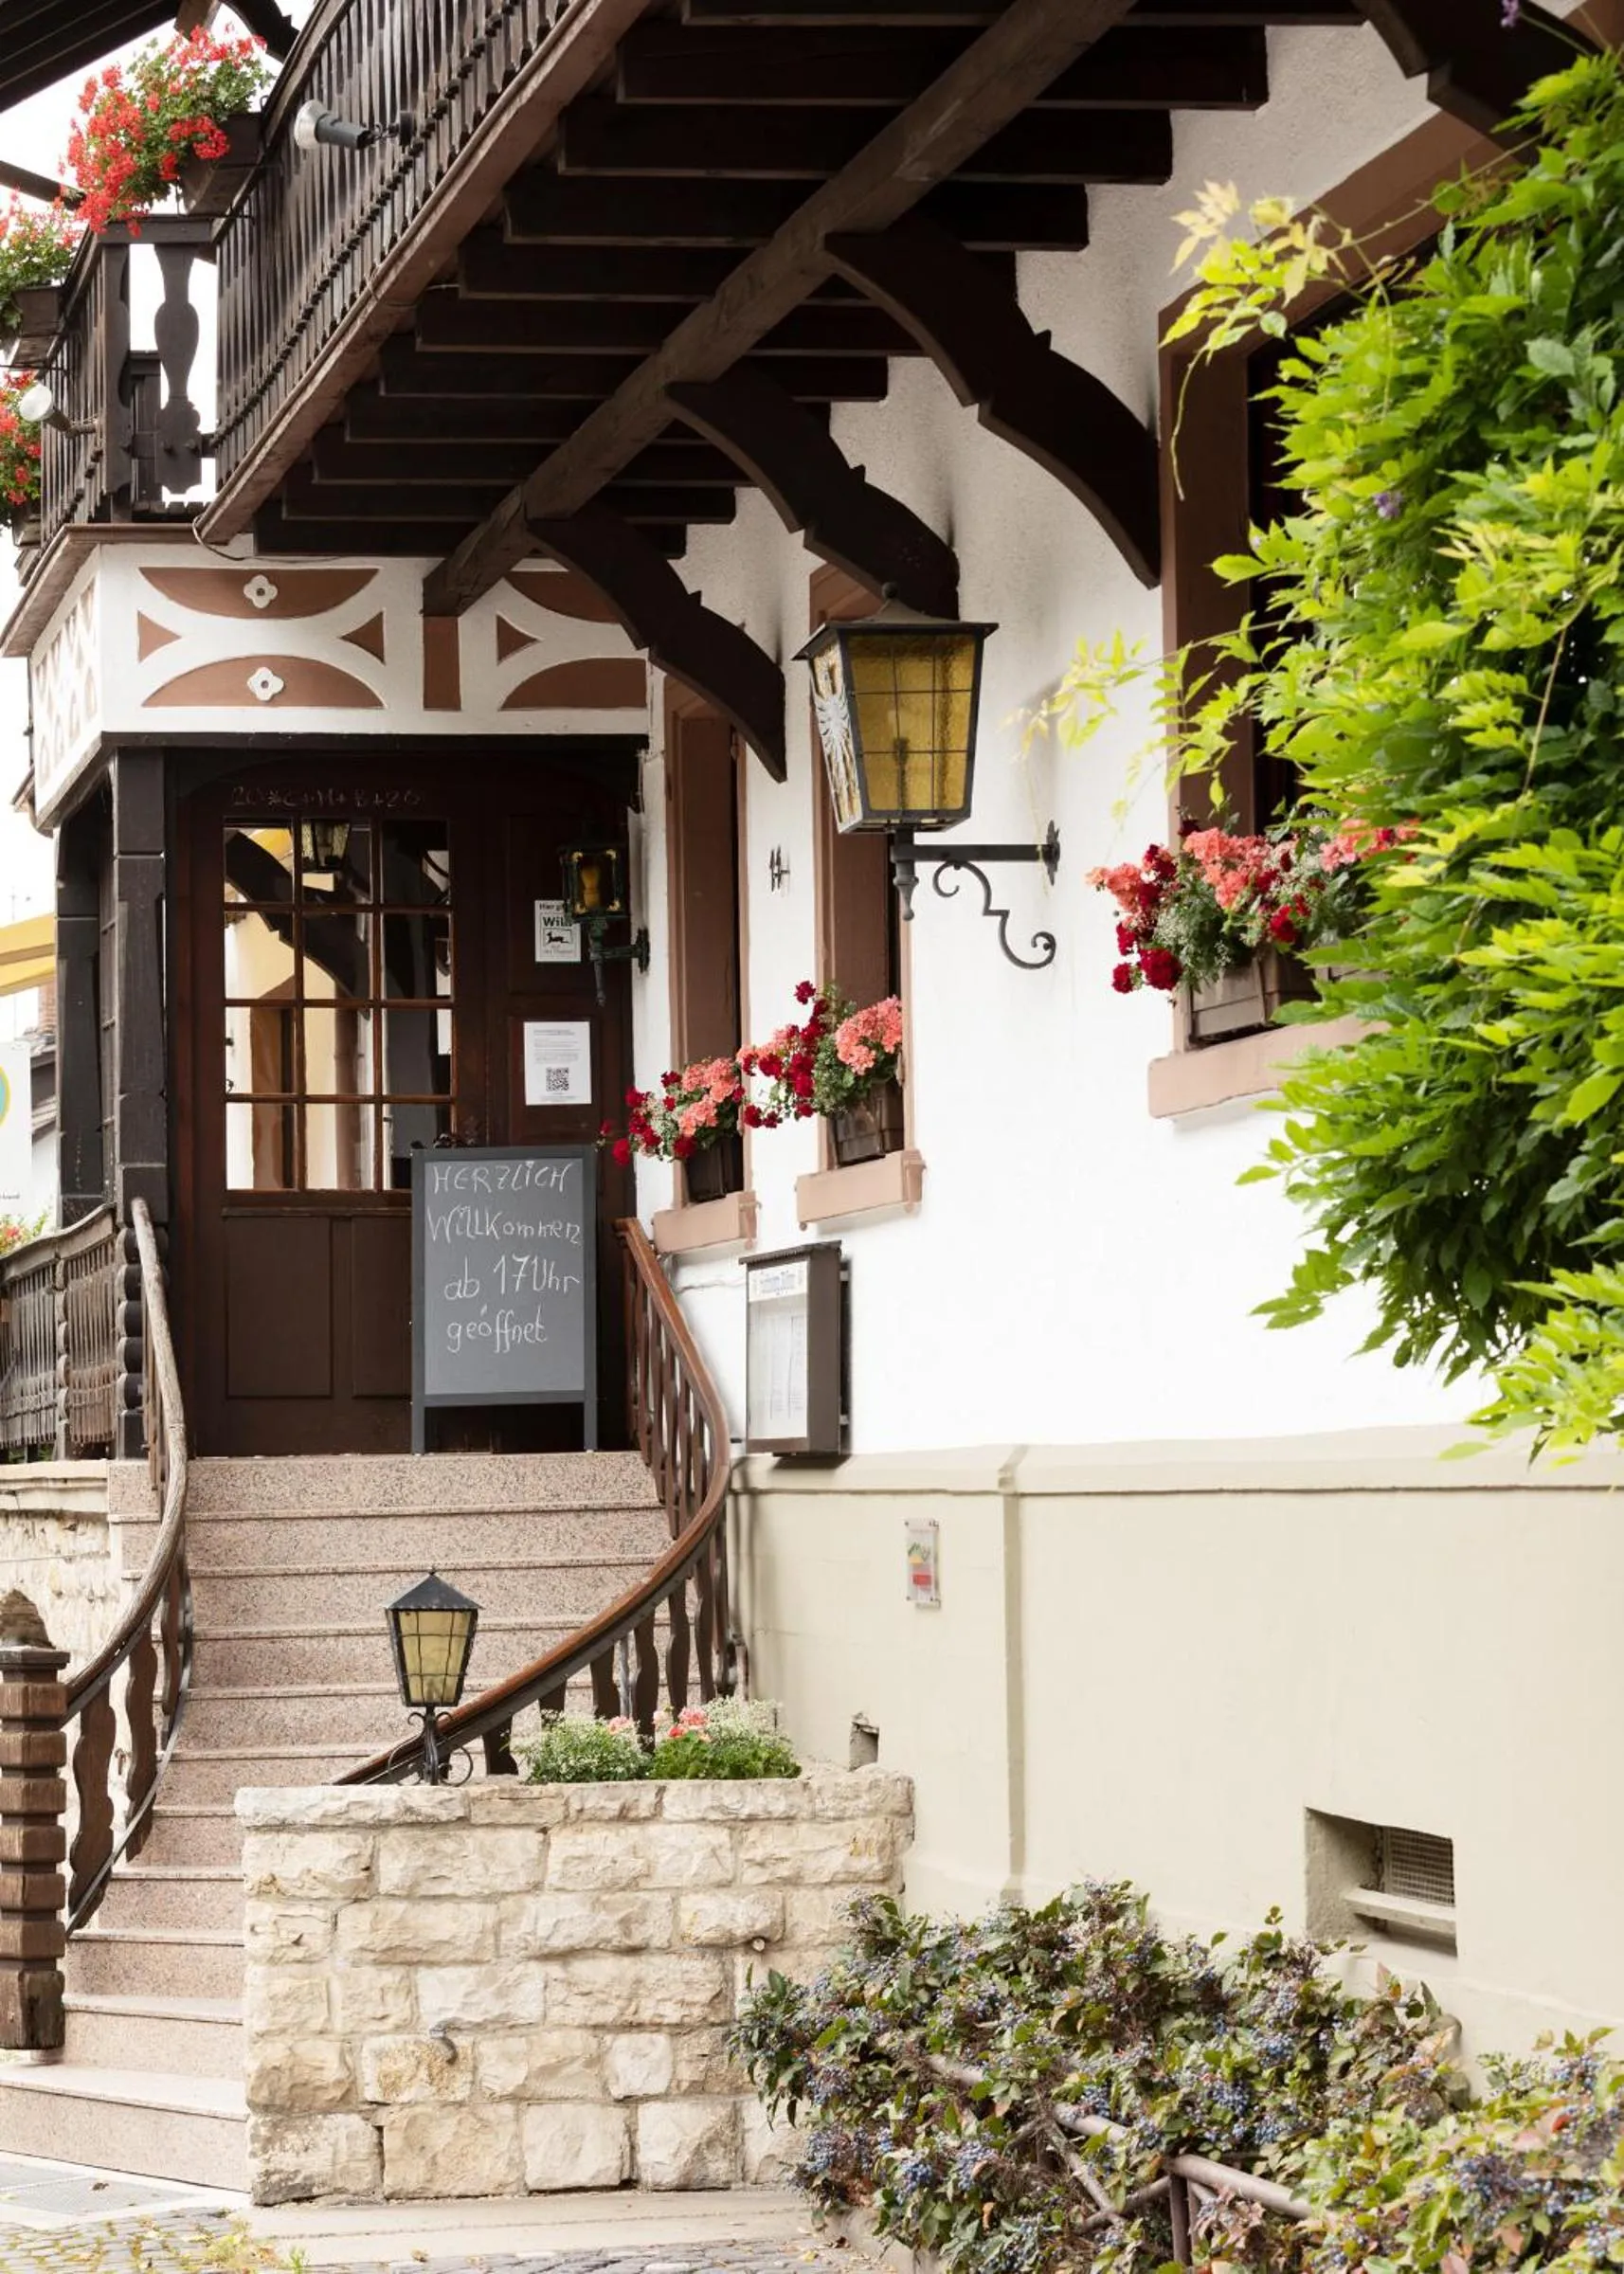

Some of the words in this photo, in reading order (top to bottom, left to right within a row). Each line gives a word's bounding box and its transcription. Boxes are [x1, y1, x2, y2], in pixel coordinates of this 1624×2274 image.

[433, 1161, 572, 1194] HERZLICH
[443, 1254, 480, 1300] ab
[446, 1304, 549, 1354] geöffnet
